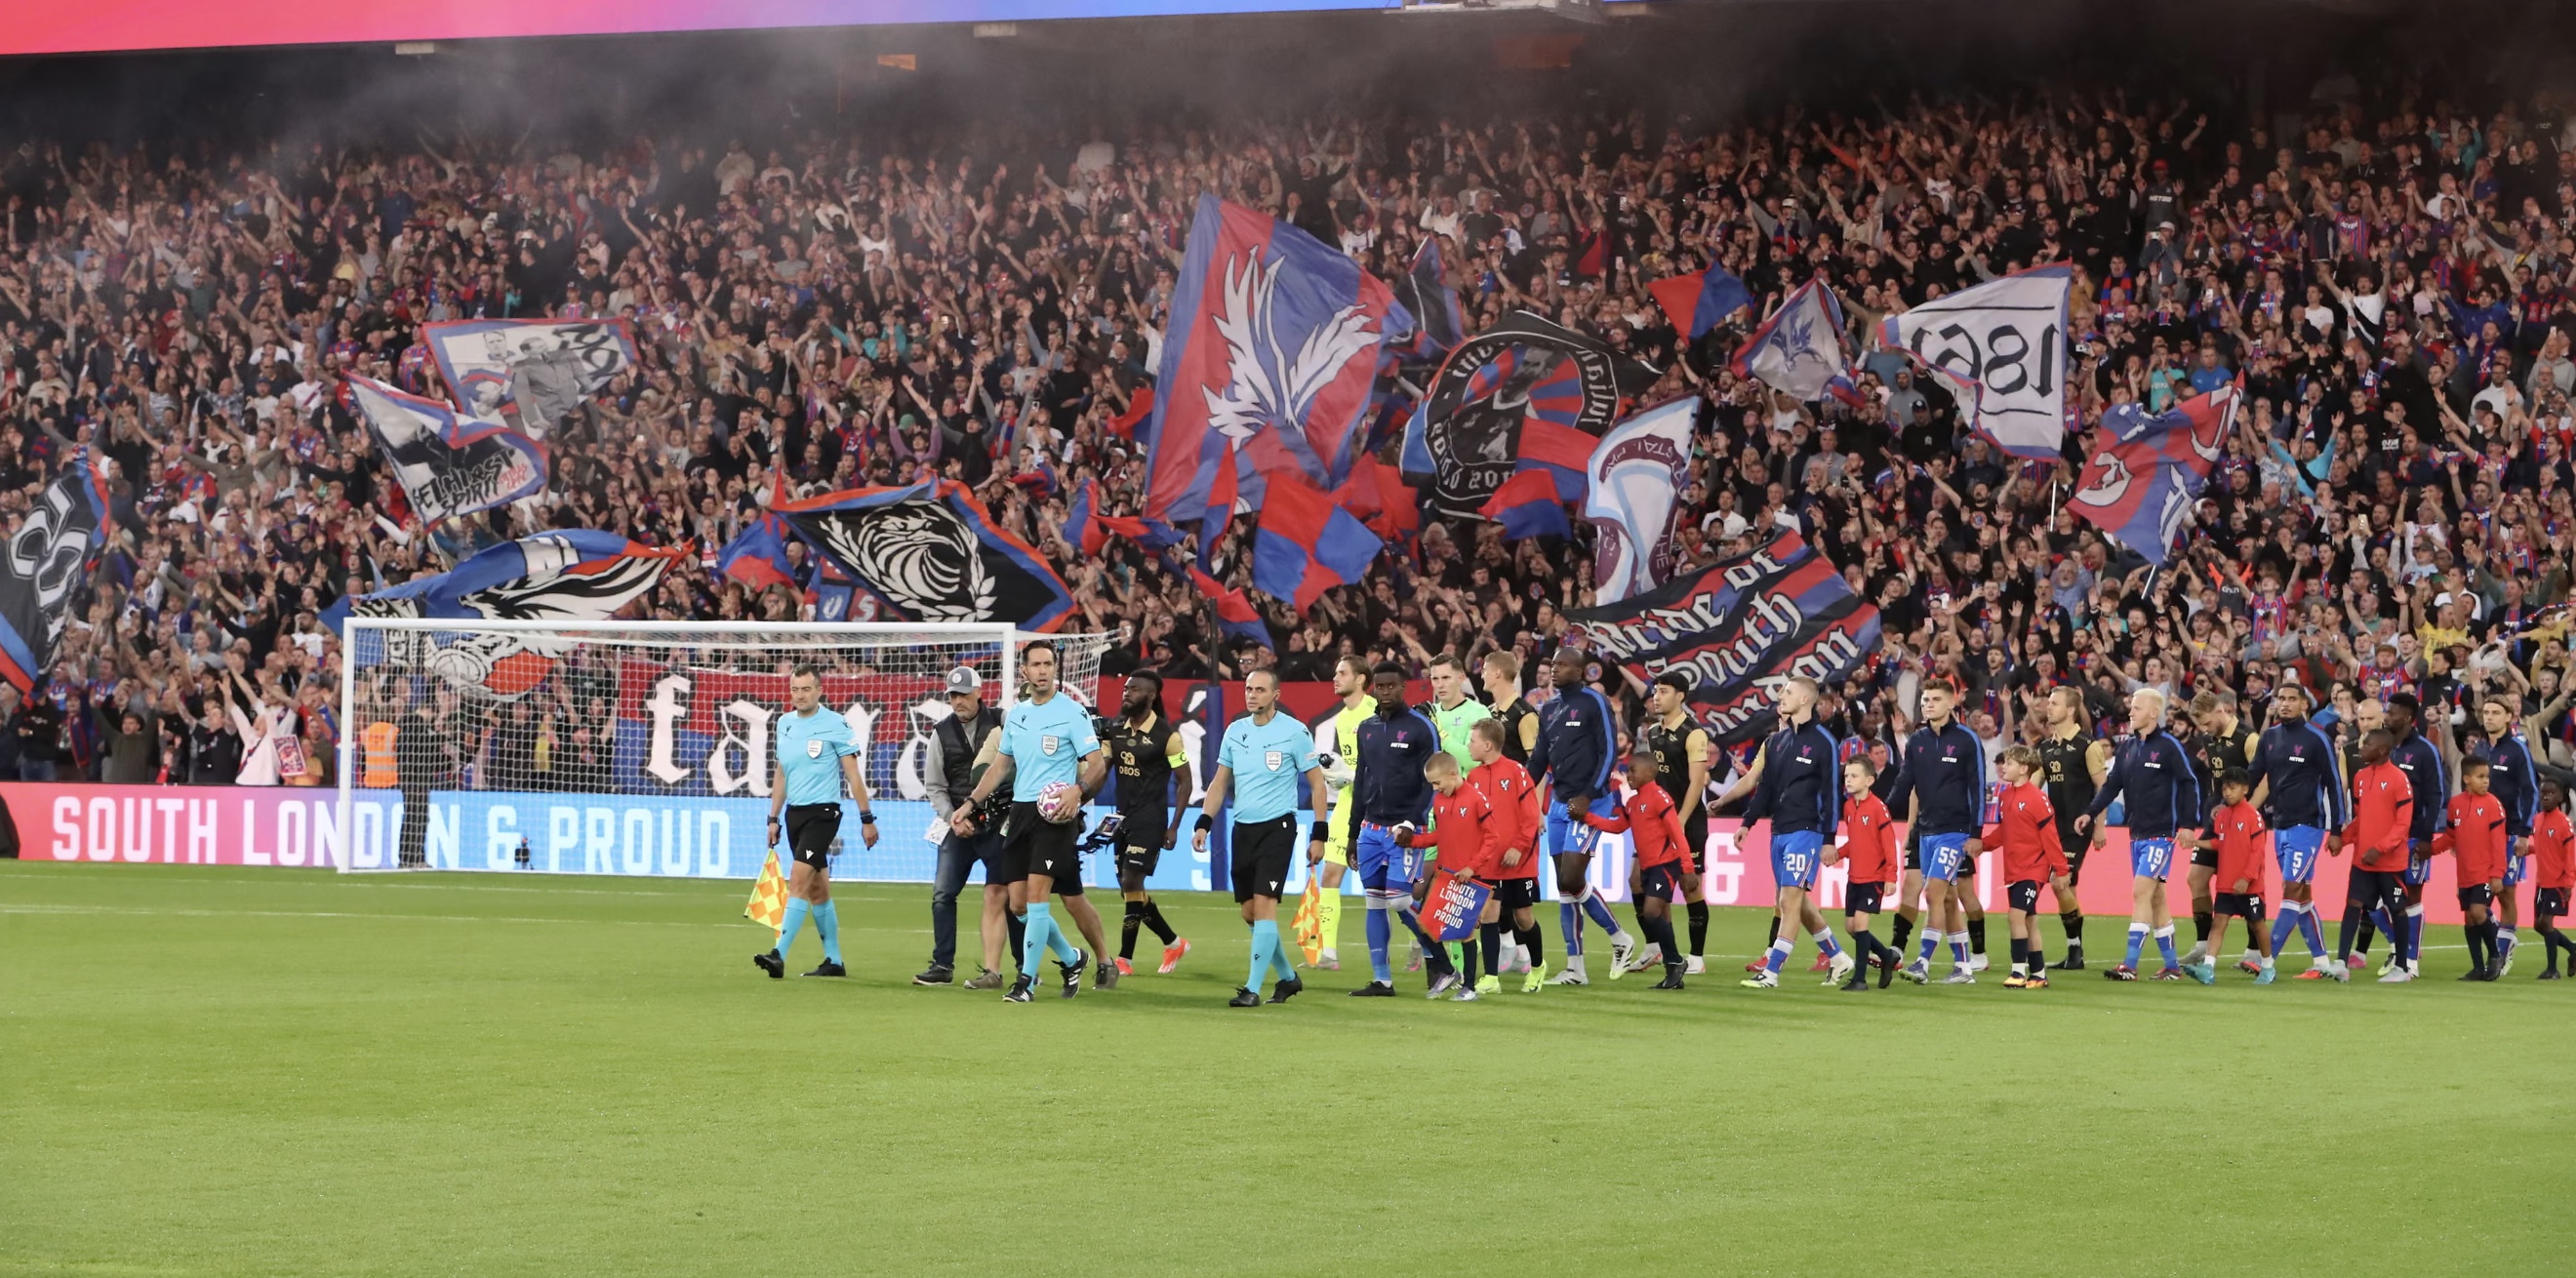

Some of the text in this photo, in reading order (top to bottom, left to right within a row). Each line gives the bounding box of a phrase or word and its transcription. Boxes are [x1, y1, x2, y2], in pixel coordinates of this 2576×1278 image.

[1572, 548, 1787, 660] Pride of
[1645, 591, 1802, 692] South
[1686, 626, 1860, 739] ondon
[1118, 766, 1141, 777] OBOS
[53, 796, 216, 863] SOUTH
[488, 805, 521, 870] &
[549, 806, 731, 878] PROUD
[1572, 820, 1590, 838] 14
[1785, 853, 1806, 872] 20
[1938, 847, 1958, 867] 55
[2147, 846, 2163, 865] 19
[2292, 851, 2304, 868] 5
[1439, 887, 1476, 911] LONDON
[1447, 879, 1476, 899] SOUTH
[1433, 909, 1463, 930] PROUD
[1443, 902, 1463, 917] AND
